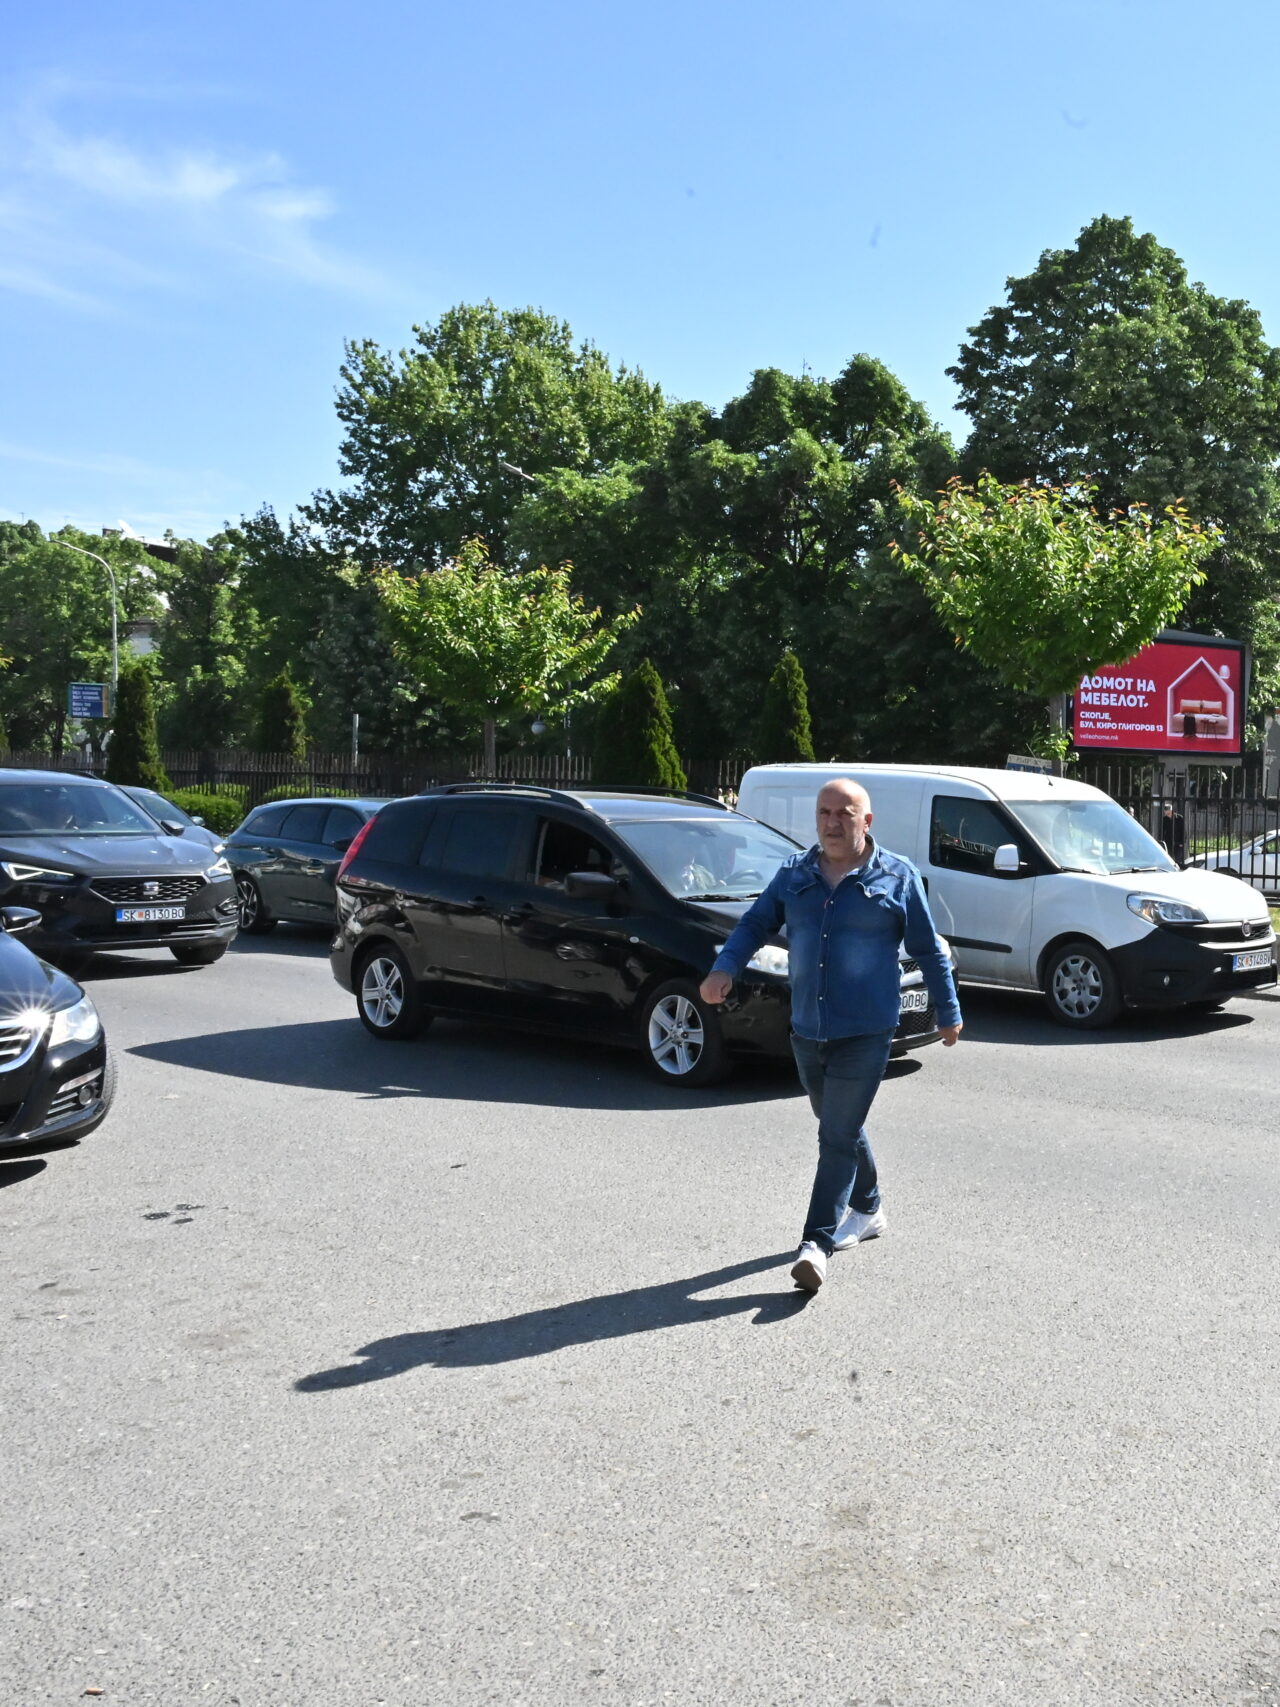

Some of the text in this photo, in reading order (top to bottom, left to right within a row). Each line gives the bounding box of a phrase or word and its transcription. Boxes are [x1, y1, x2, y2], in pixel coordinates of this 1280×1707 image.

[1080, 675, 1156, 692] ДОМОТ НА
[1080, 692, 1149, 708] МЕБЕЛОТ.
[1080, 711, 1111, 720] СКОПЈЕ,
[1080, 721, 1095, 729] БУЛ.
[1097, 722, 1117, 730] КИРО
[1119, 723, 1155, 731] ГЛИГОРОВ
[124, 910, 136, 921] SK
[901, 993, 927, 1009] 00BC
